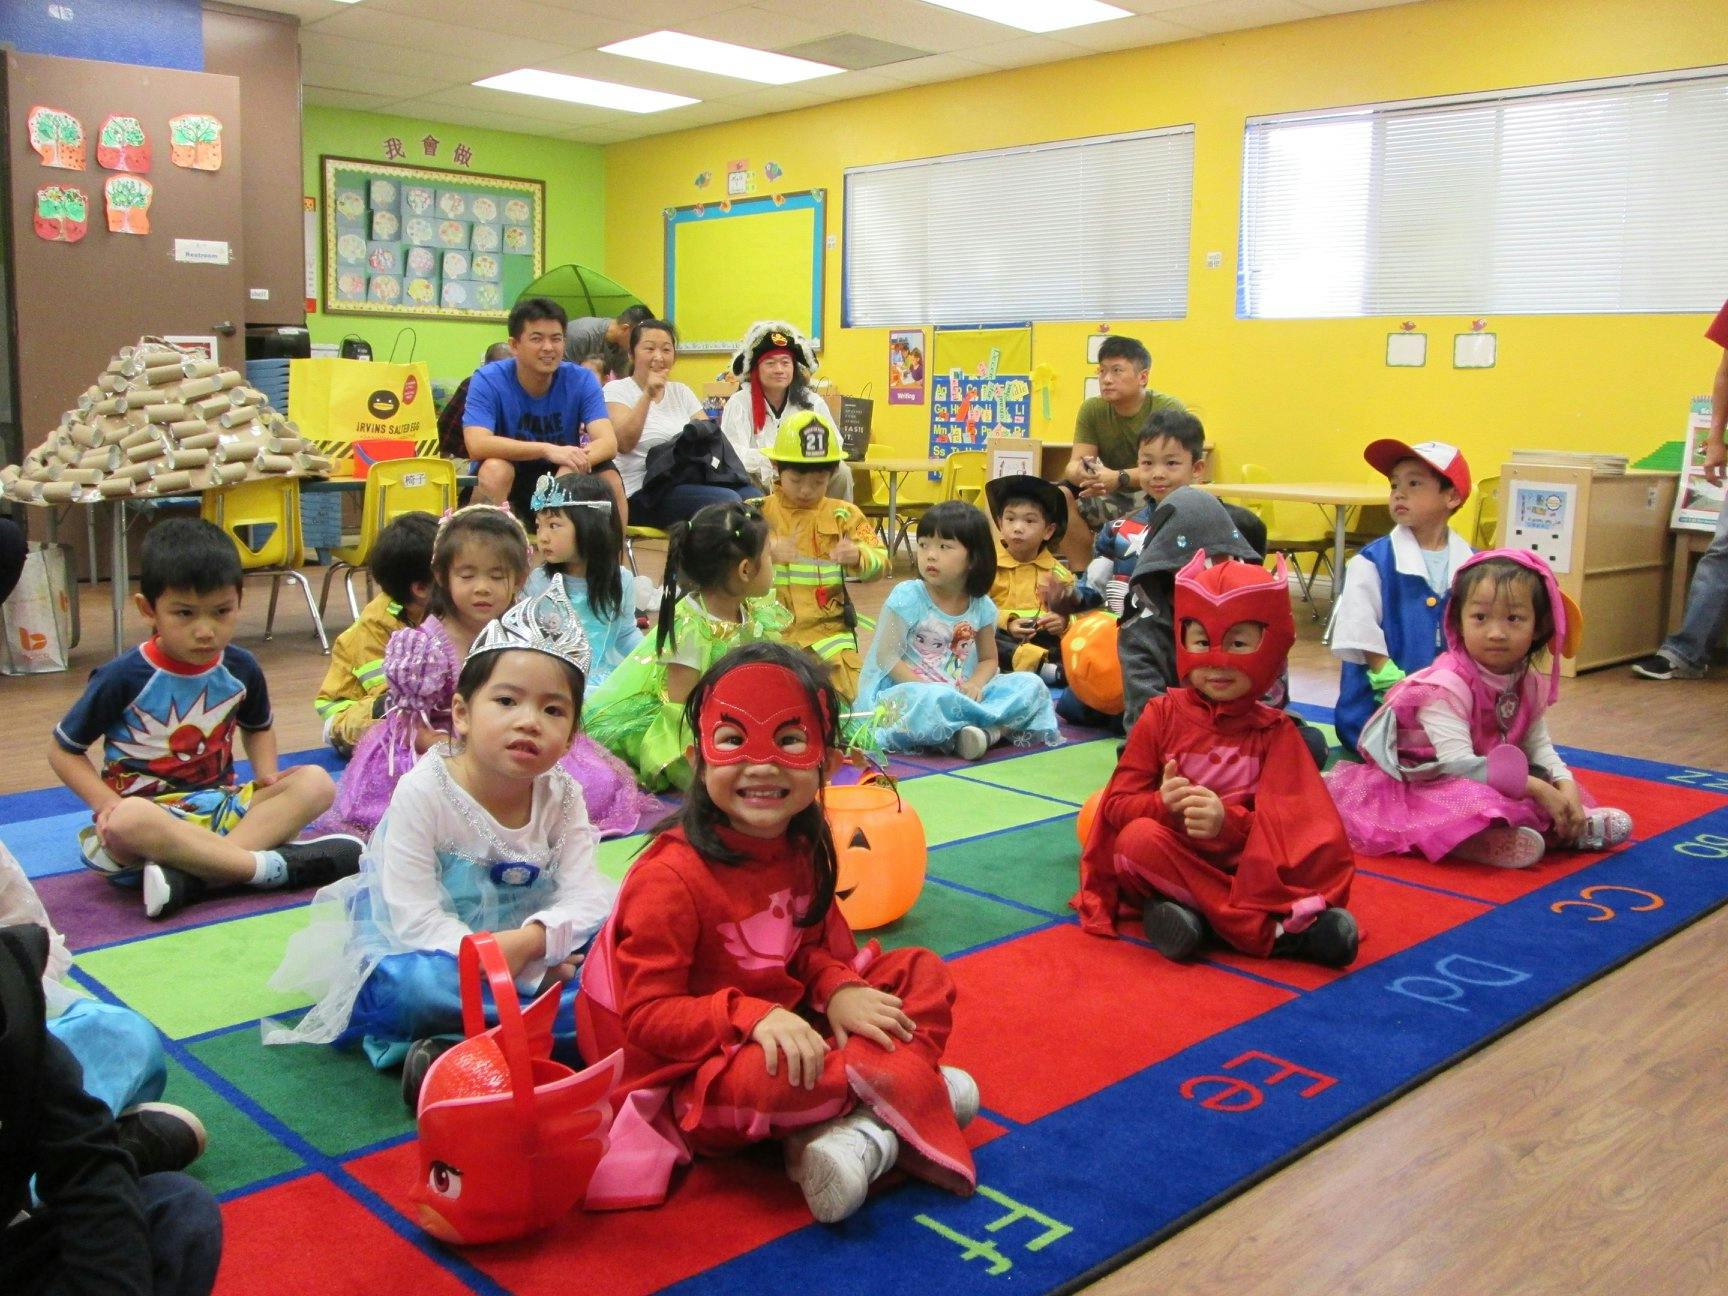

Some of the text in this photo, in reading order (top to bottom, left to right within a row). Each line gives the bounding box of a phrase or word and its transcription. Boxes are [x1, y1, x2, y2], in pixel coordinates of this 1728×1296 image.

[384, 134, 472, 168] 我會做
[897, 392, 916, 401] Writing
[357, 422, 420, 434] IRVINS SALTED EGG
[806, 433, 823, 450] 21
[1551, 885, 1664, 921] Cc
[1179, 1050, 1339, 1113] Ee
[913, 1184, 1074, 1276] Ff
